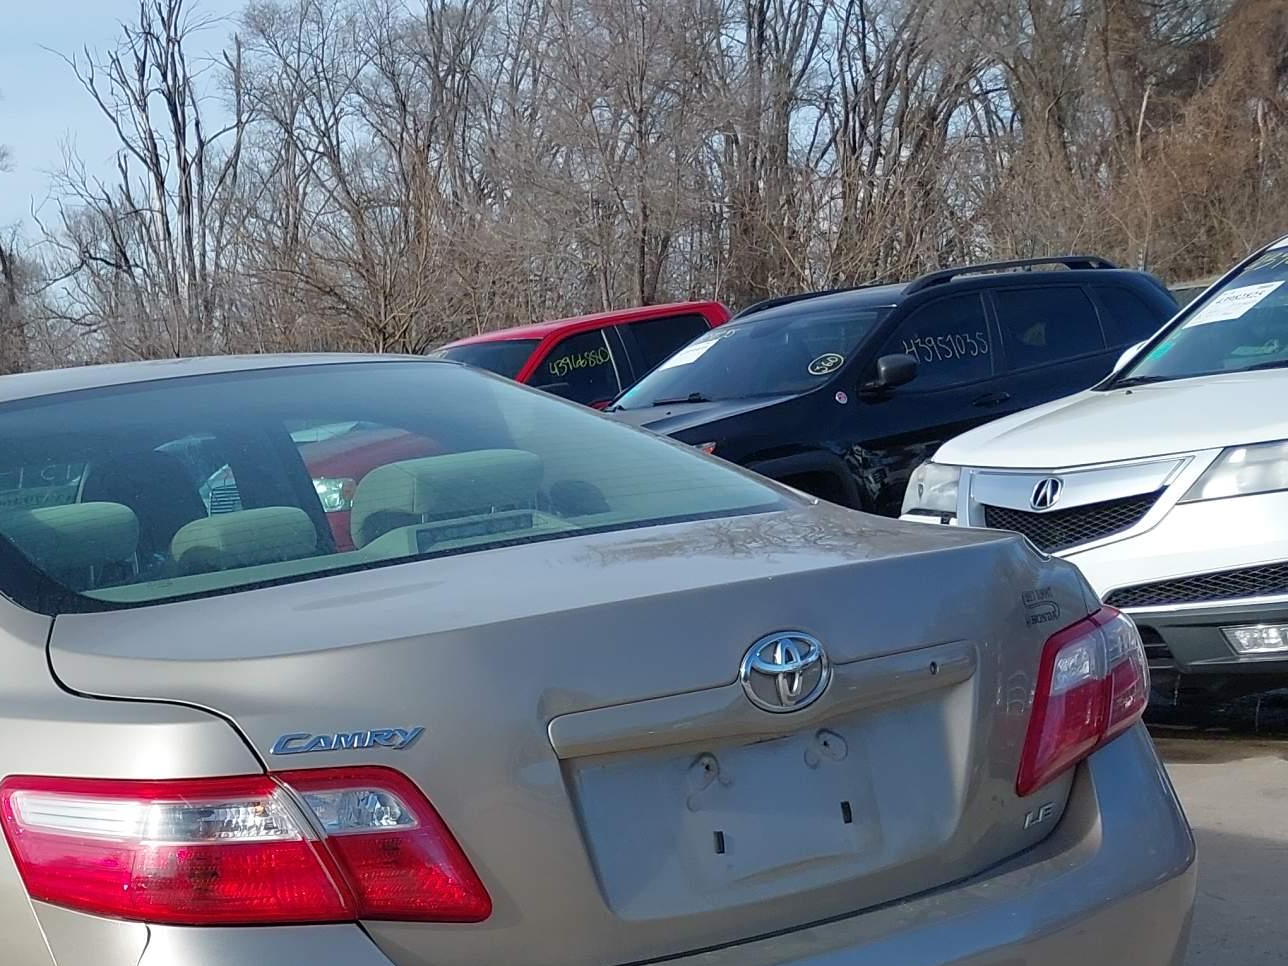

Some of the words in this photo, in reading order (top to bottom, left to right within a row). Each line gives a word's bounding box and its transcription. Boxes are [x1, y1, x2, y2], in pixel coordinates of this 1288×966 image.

[902, 331, 989, 363] 43951035
[269, 726, 427, 755] CAMRY
[1023, 801, 1057, 830] LE
